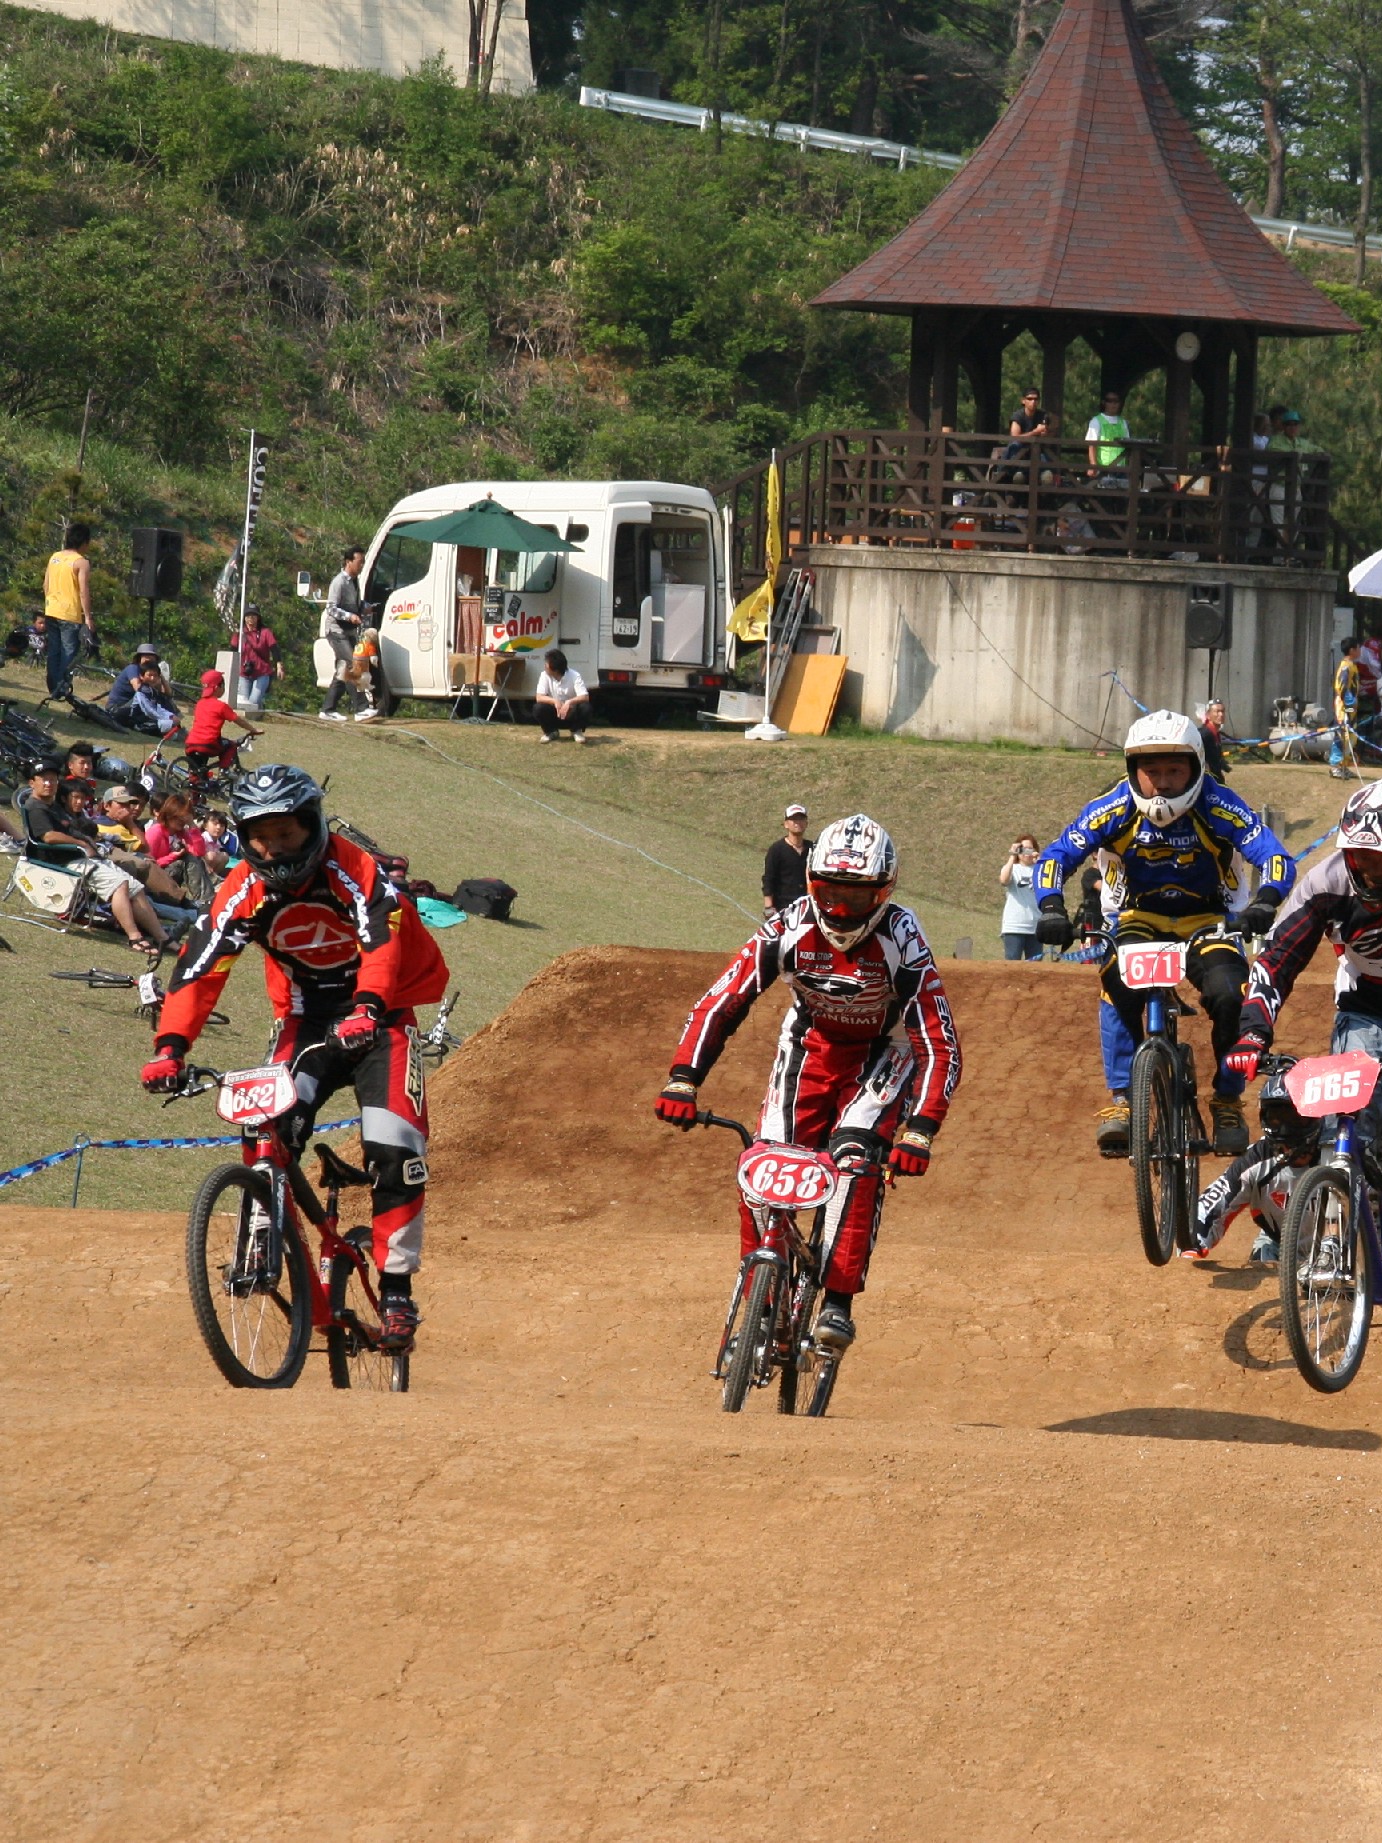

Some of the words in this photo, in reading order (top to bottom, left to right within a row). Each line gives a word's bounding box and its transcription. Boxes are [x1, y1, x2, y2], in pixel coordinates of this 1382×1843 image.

[391, 600, 415, 614] calm
[493, 611, 543, 639] calm
[800, 951, 815, 960] KOOL
[817, 952, 833, 961] STOP
[1129, 953, 1174, 981] 671
[1304, 1070, 1361, 1104] 665
[752, 1158, 822, 1199] 658
